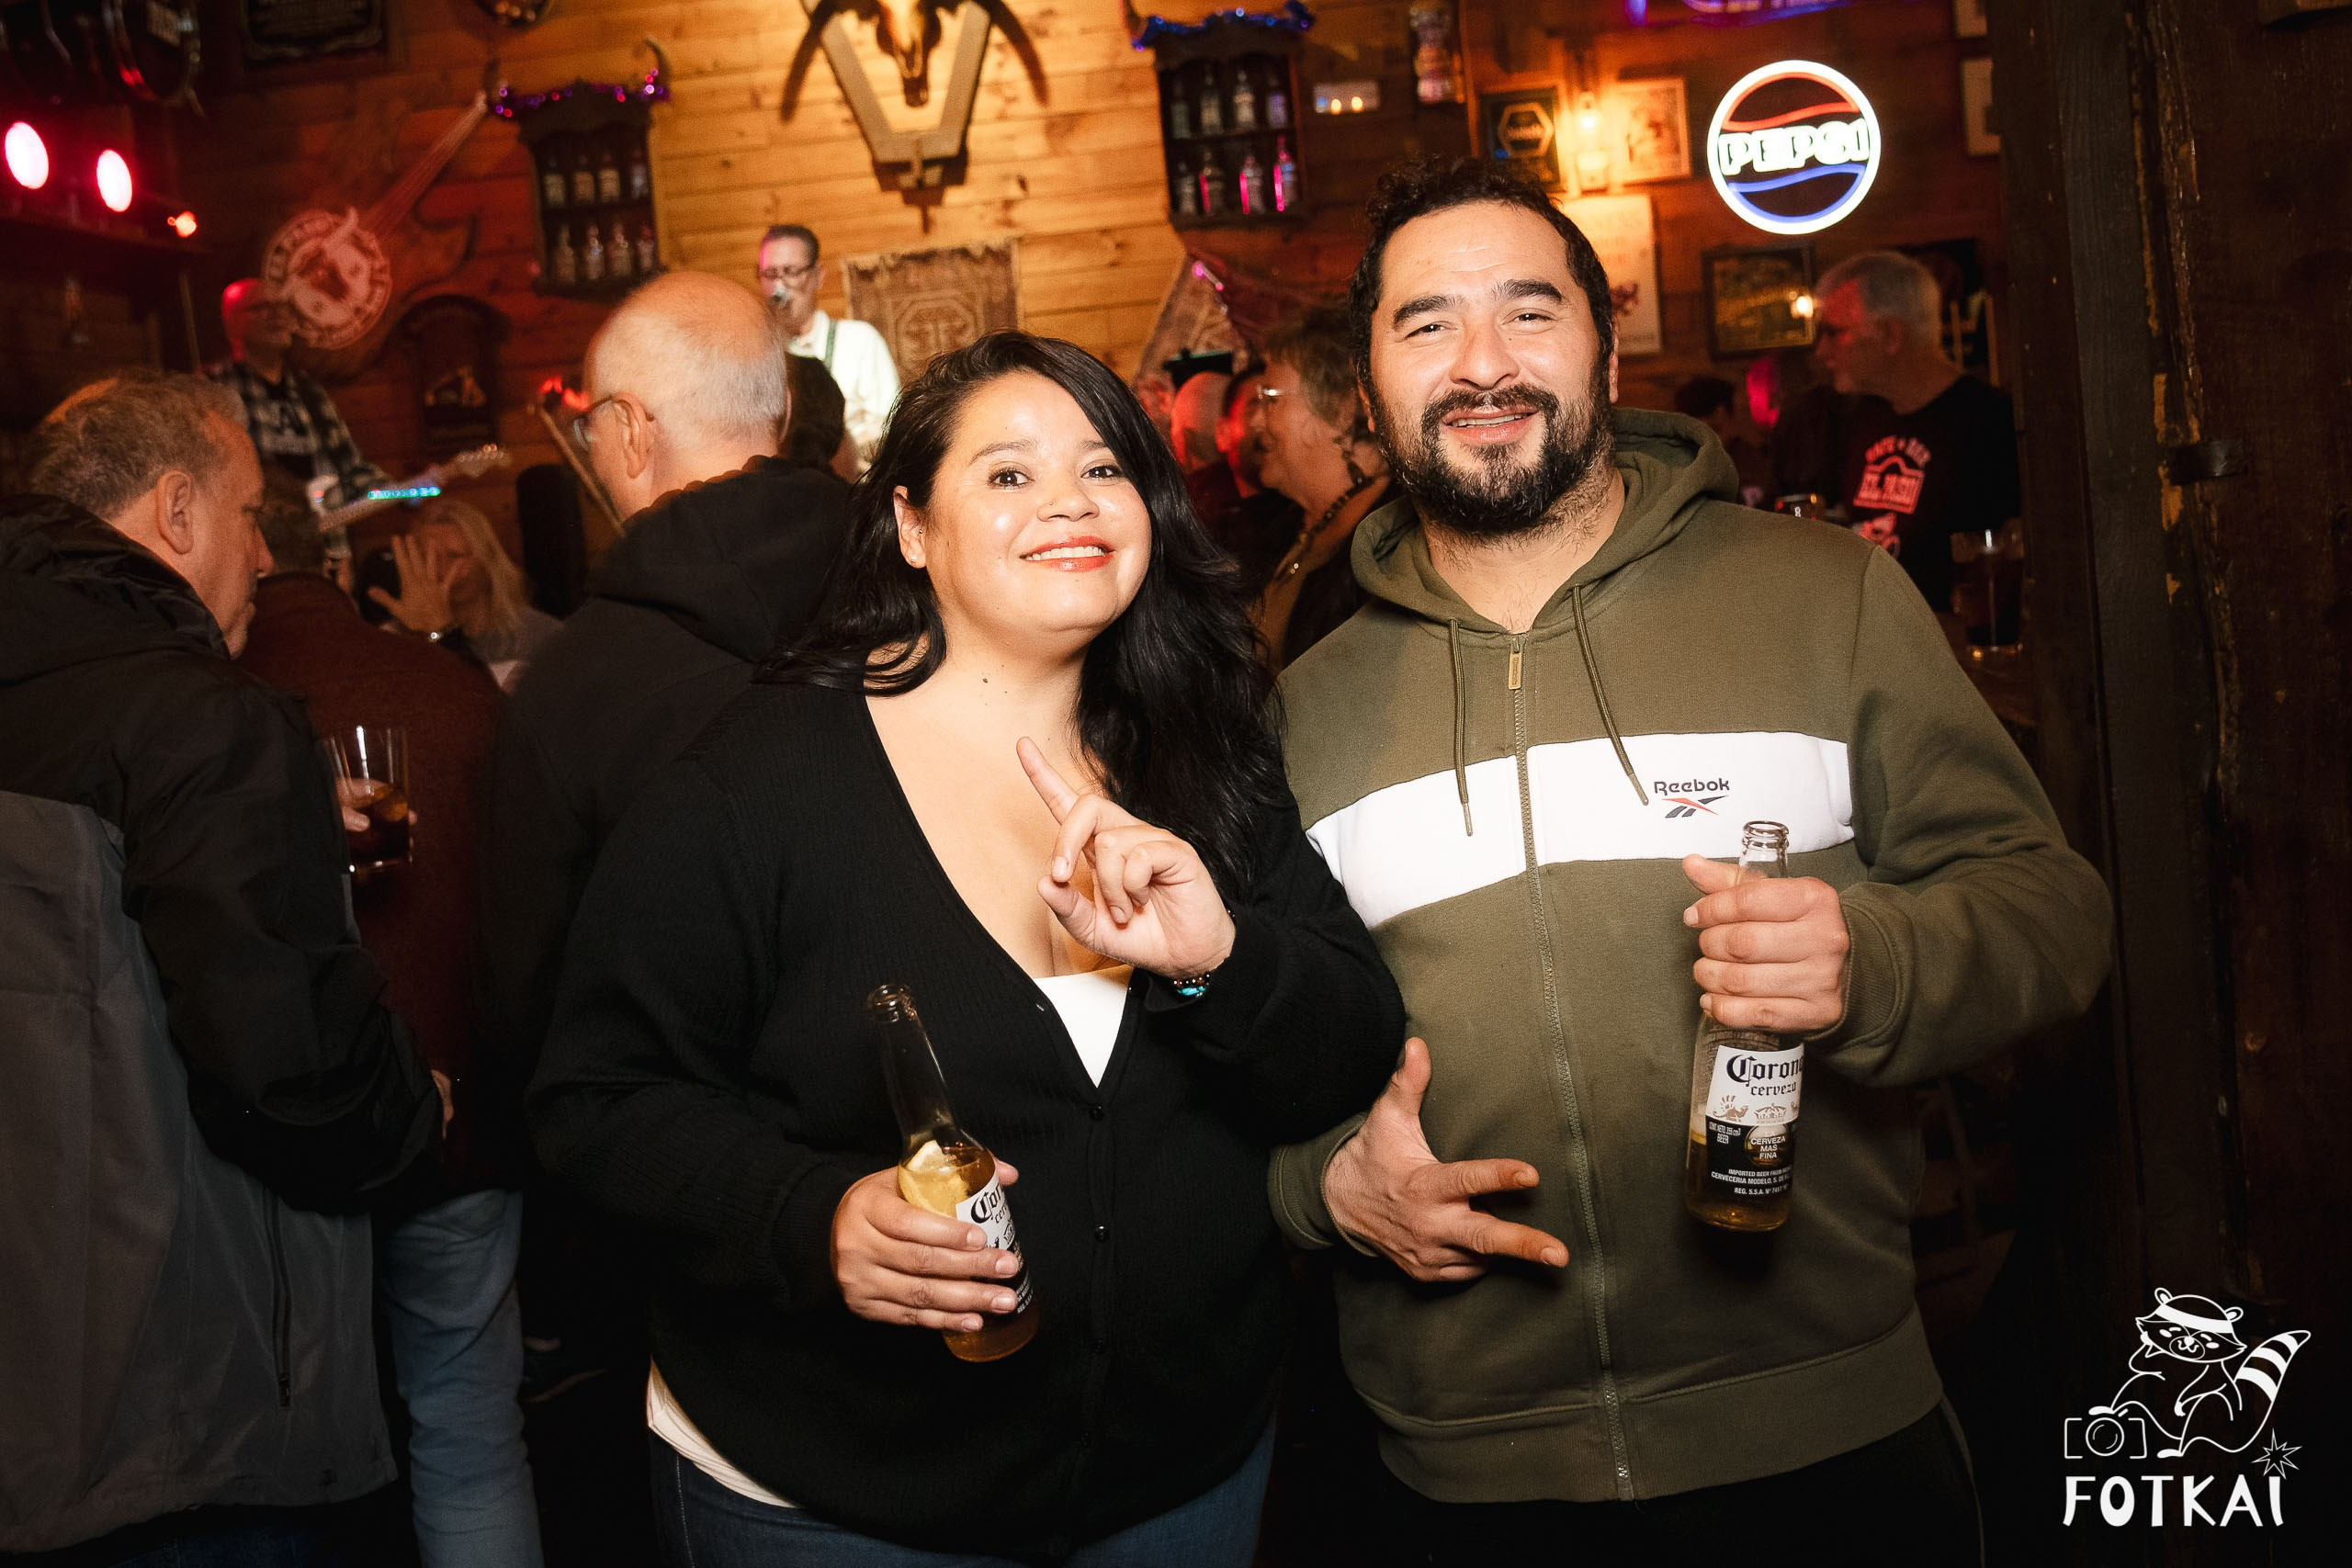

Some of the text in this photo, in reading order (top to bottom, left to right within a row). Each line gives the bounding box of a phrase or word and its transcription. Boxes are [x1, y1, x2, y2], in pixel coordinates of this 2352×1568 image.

[1718, 118, 1870, 175] PEPSI
[1654, 778, 1730, 795] Reebok
[1750, 1135, 1786, 1145] CERVEZA
[1760, 1144, 1778, 1152] MAS
[1711, 1171, 1747, 1184] CERVECERIA
[1728, 1168, 1756, 1177] IMPORTED
[1734, 1187, 1747, 1195] REG.
[971, 1182, 1003, 1224] Cor
